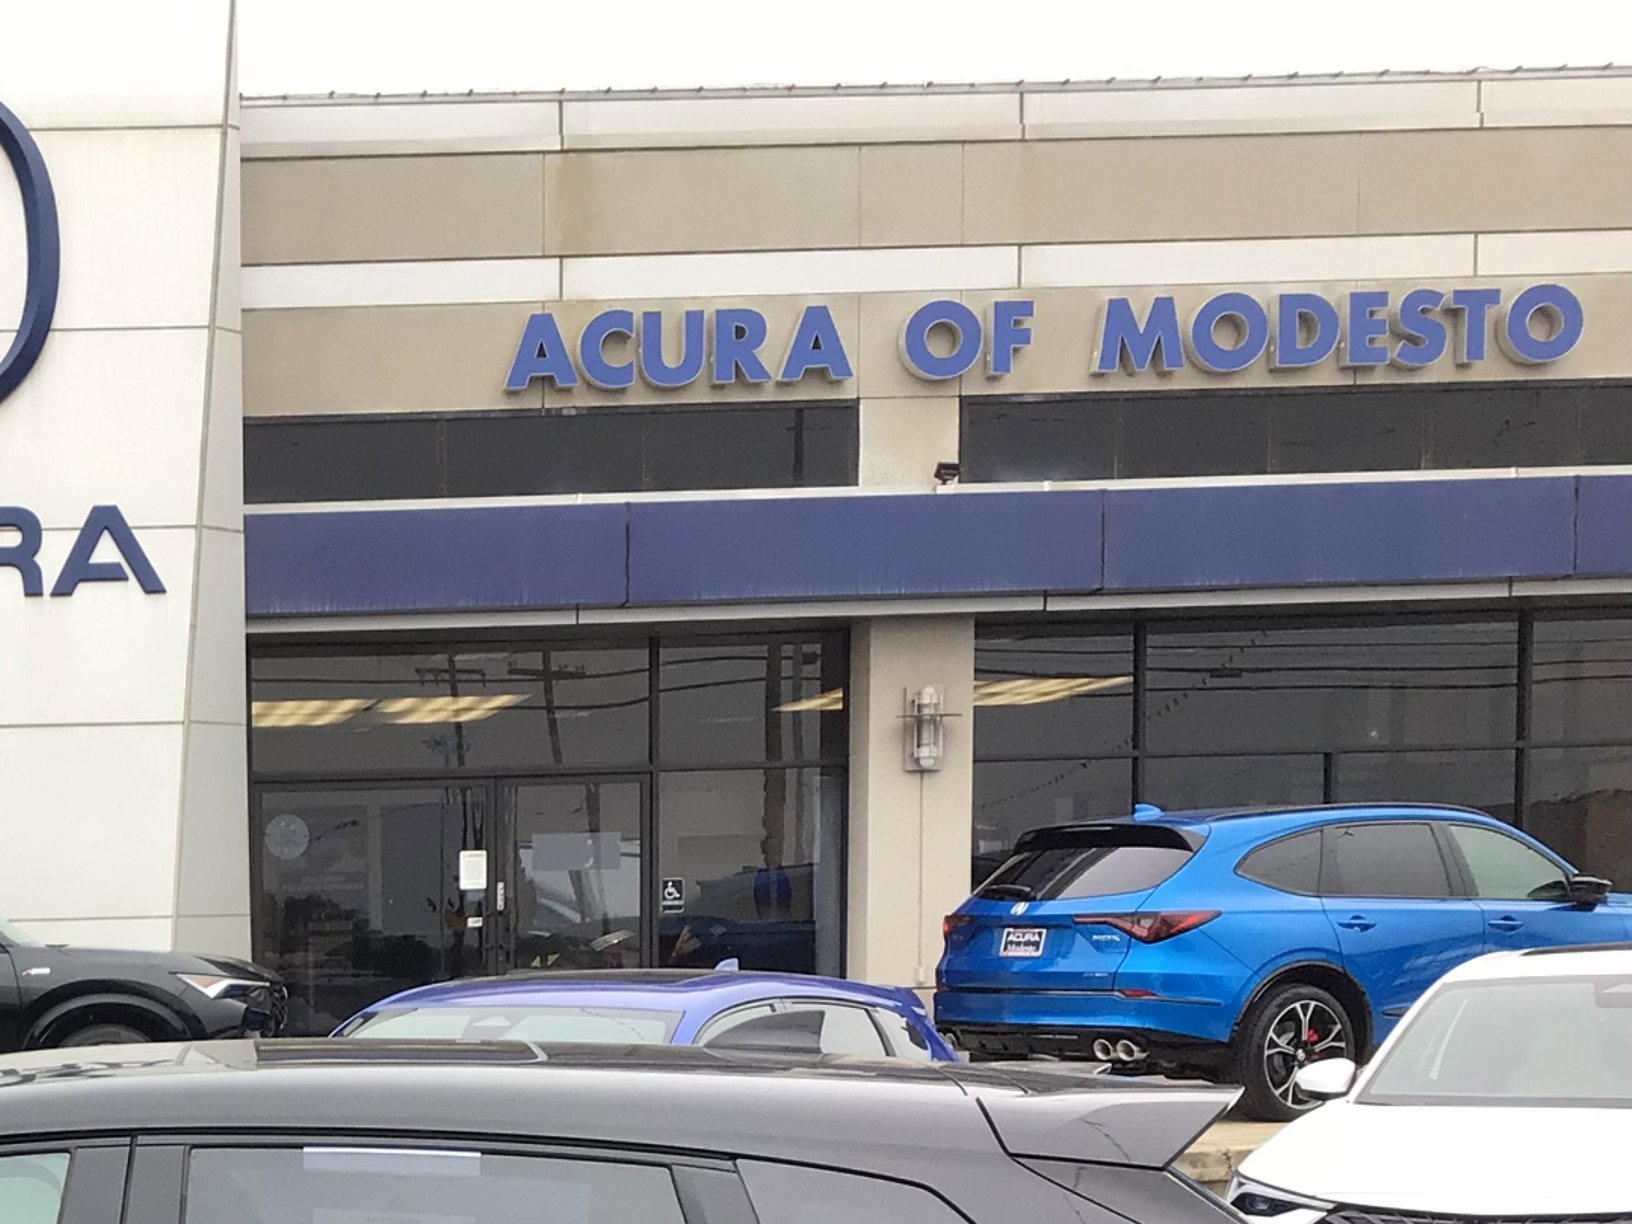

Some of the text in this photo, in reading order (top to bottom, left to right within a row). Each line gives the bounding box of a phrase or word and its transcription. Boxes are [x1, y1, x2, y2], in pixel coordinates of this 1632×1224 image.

[504, 283, 1586, 391] ACURA OF MODESTO
[1007, 932, 1041, 942] ACURA
